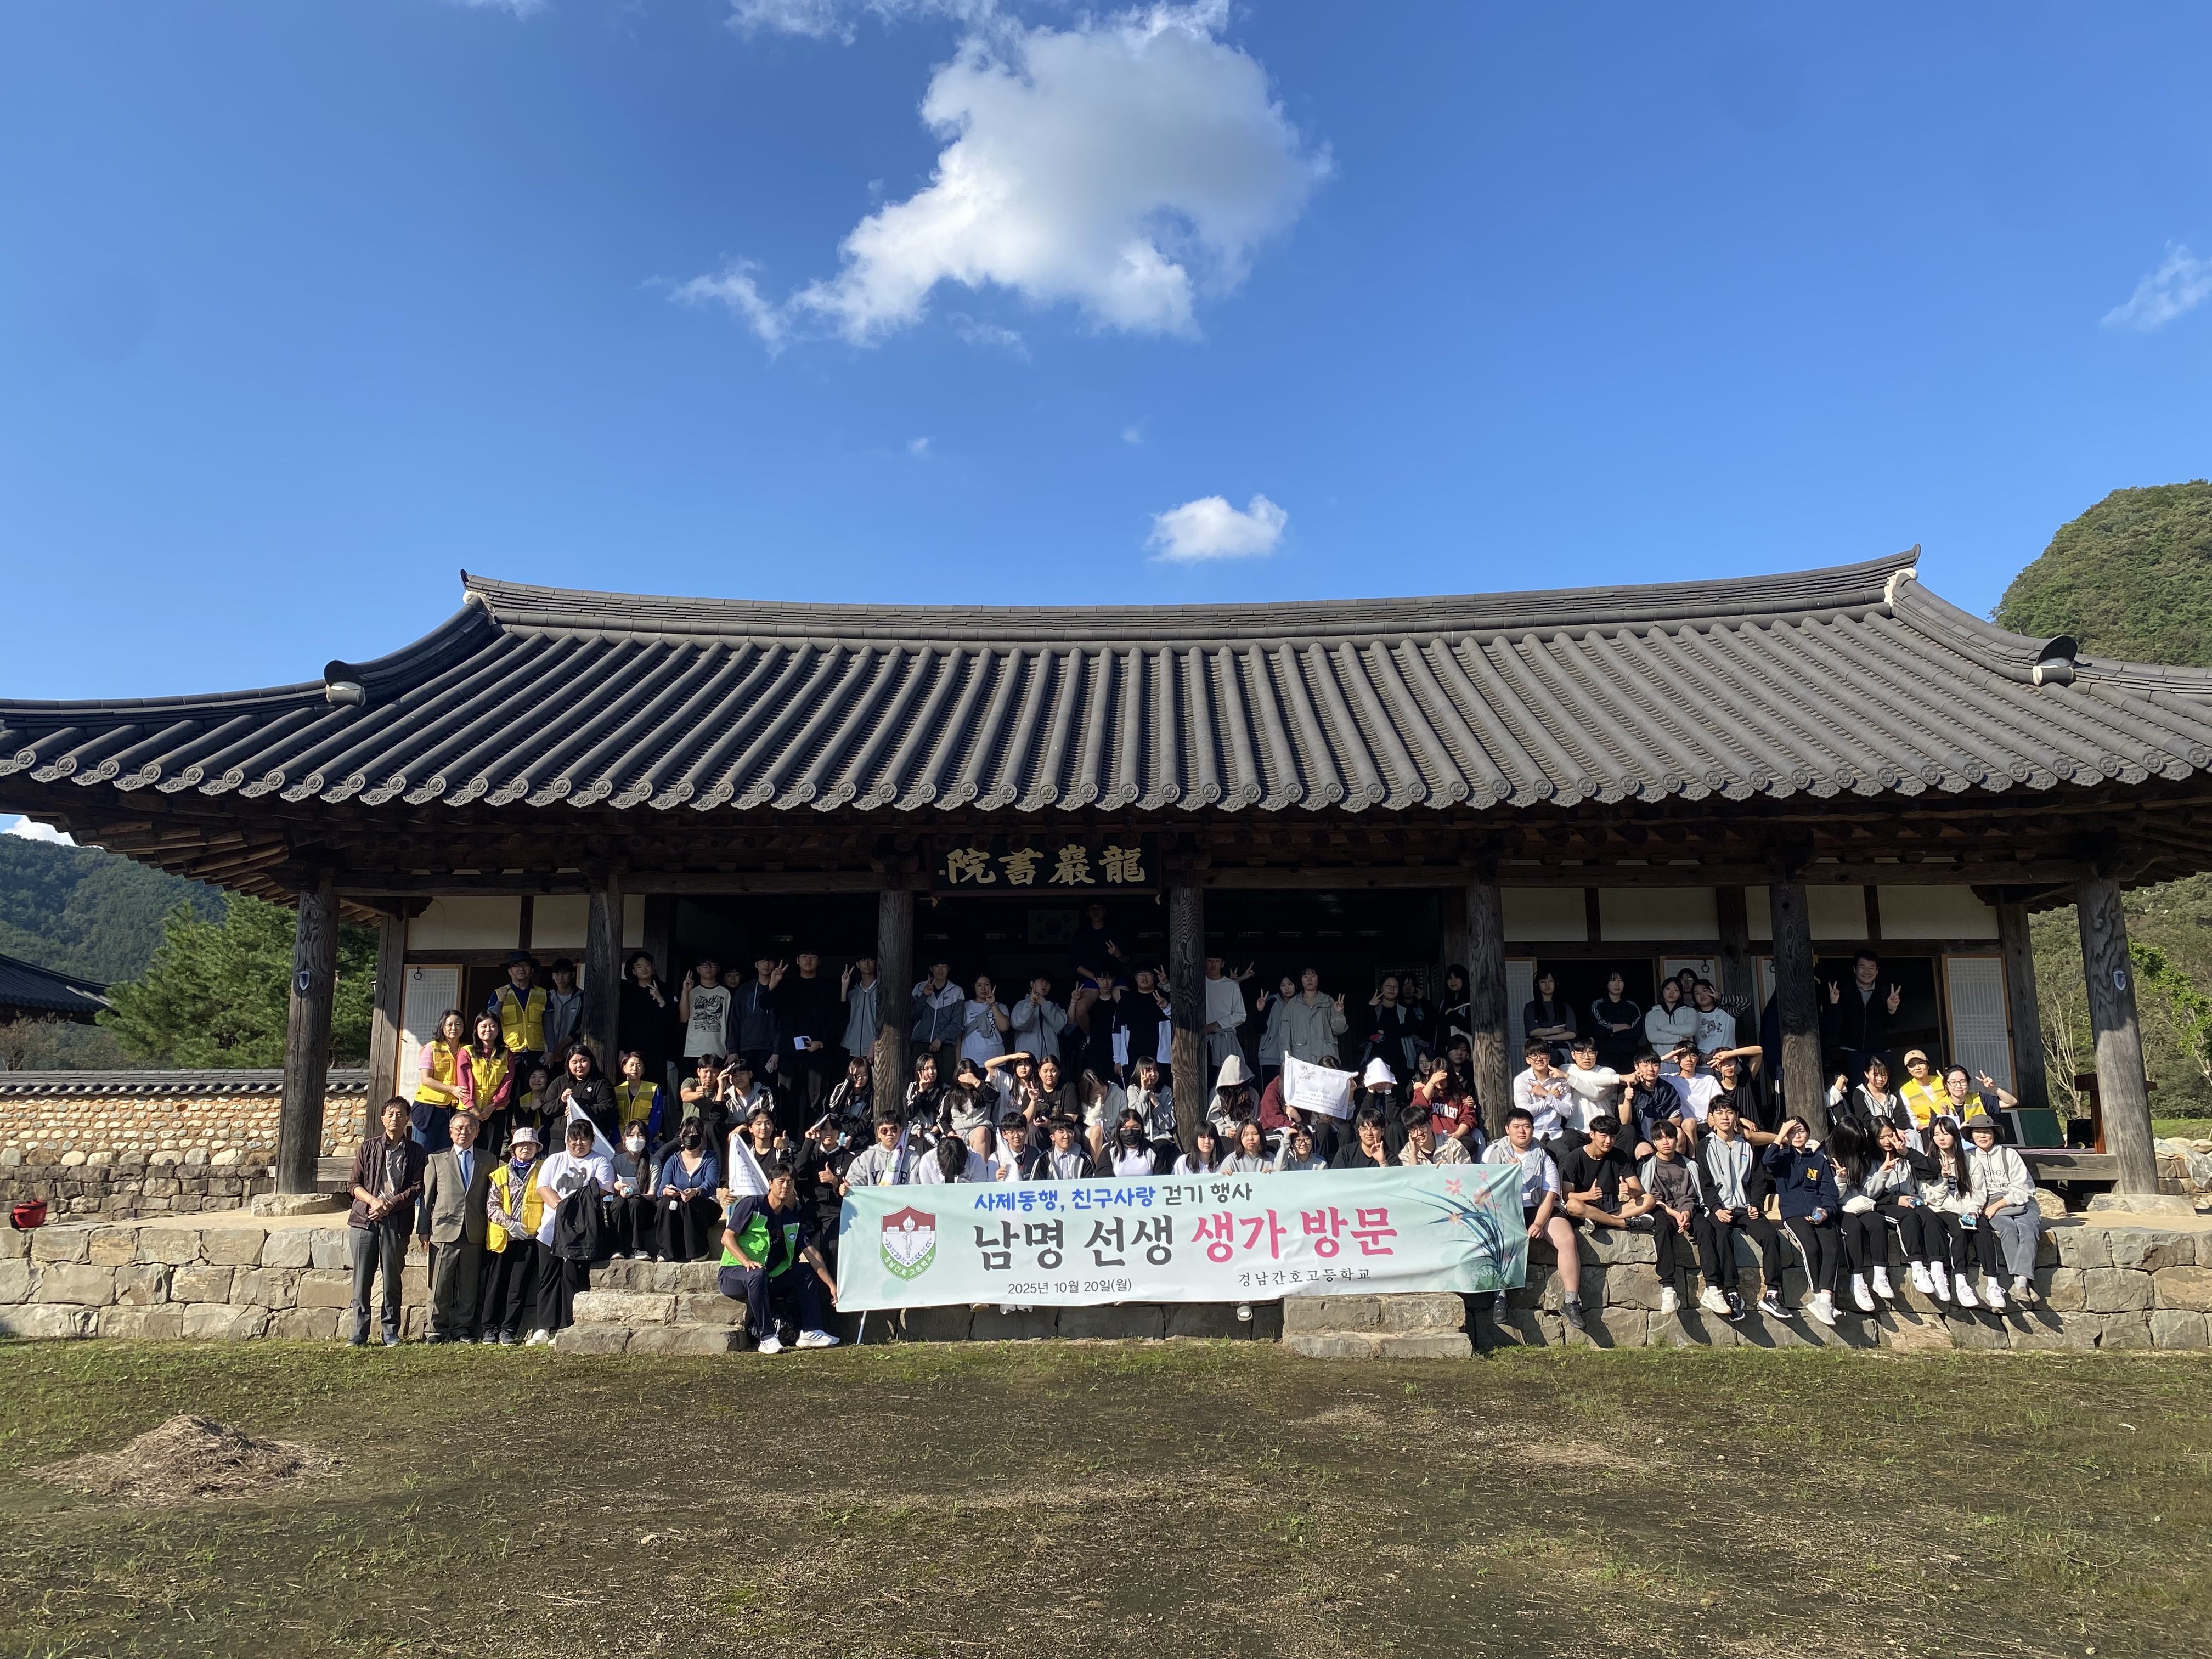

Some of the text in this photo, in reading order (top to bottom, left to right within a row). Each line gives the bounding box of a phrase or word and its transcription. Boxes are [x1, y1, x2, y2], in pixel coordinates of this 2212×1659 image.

[974, 1182, 1253, 1213] 사제동행, 친구사랑 걷기 행사
[973, 1206, 1398, 1271] 남명 선생 생가 방문
[1007, 1278, 1132, 1295] 2025년 10월 20일(월)
